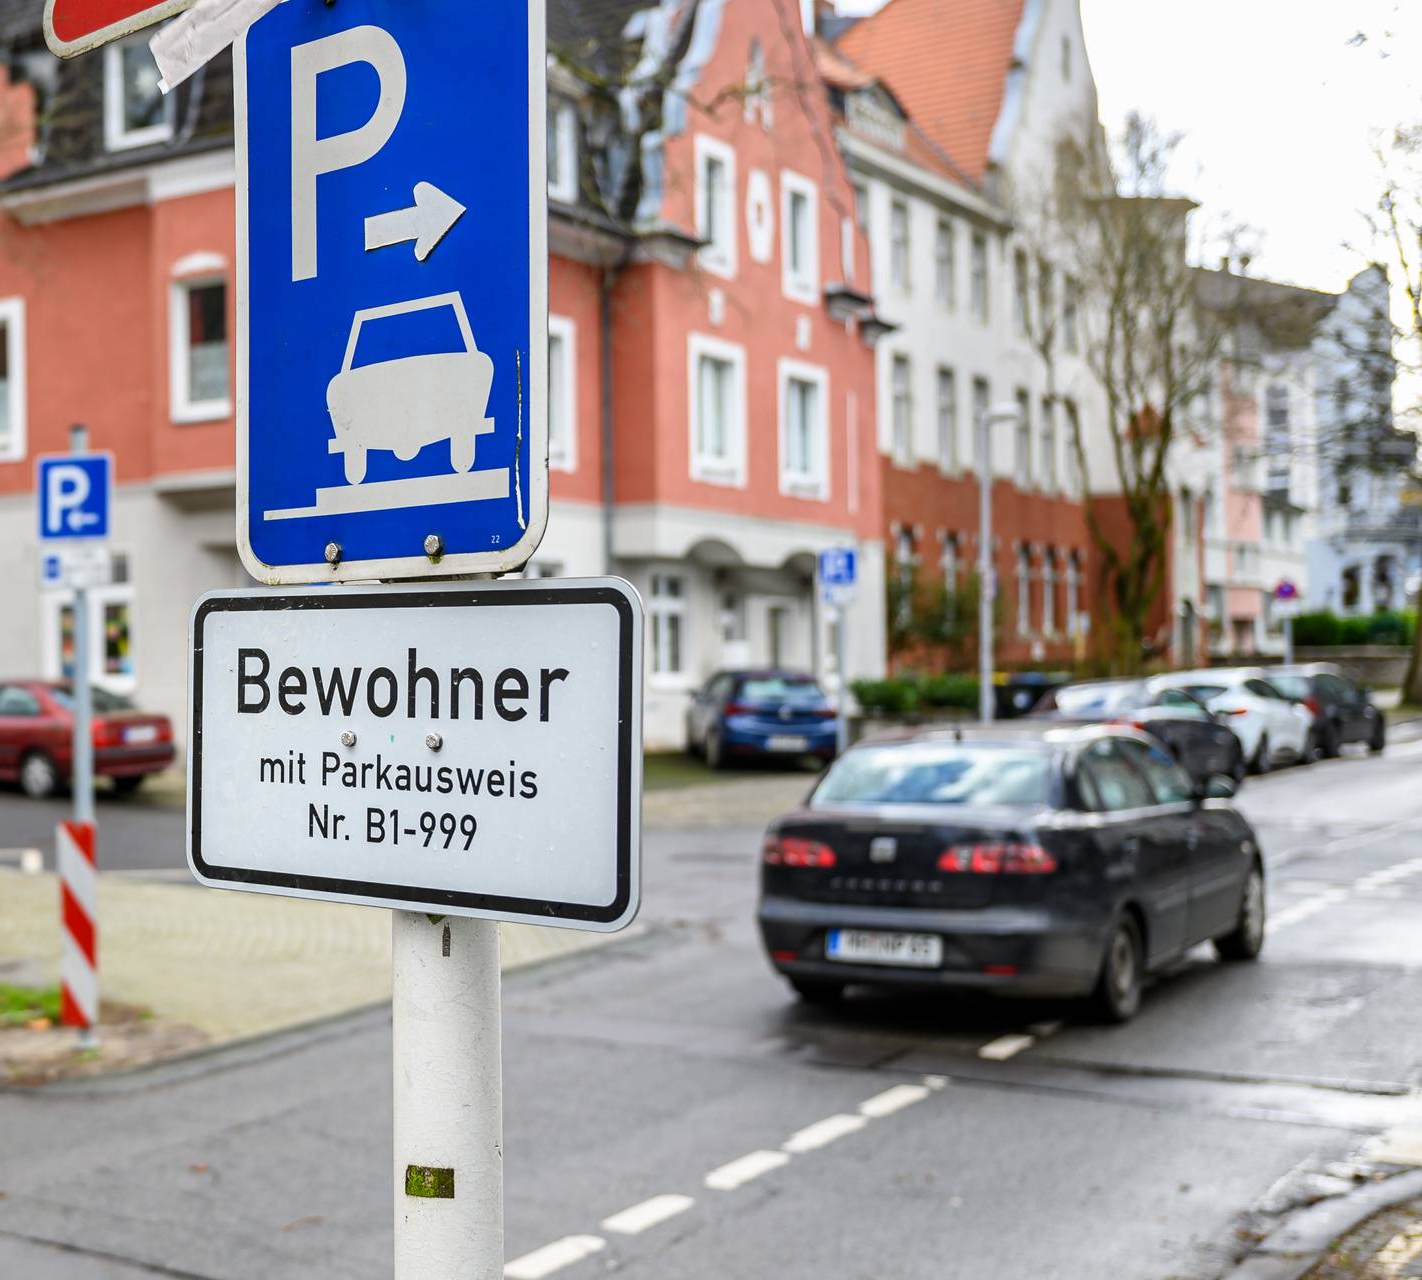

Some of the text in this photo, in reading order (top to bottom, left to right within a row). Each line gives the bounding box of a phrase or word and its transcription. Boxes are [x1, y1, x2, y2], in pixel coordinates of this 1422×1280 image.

[290, 24, 407, 282] P
[47, 464, 91, 533] P
[490, 534, 501, 544] 22
[236, 647, 571, 723] Bewohner
[259, 749, 539, 800] mit Parkausweis
[308, 803, 478, 851] Nr. B1-999
